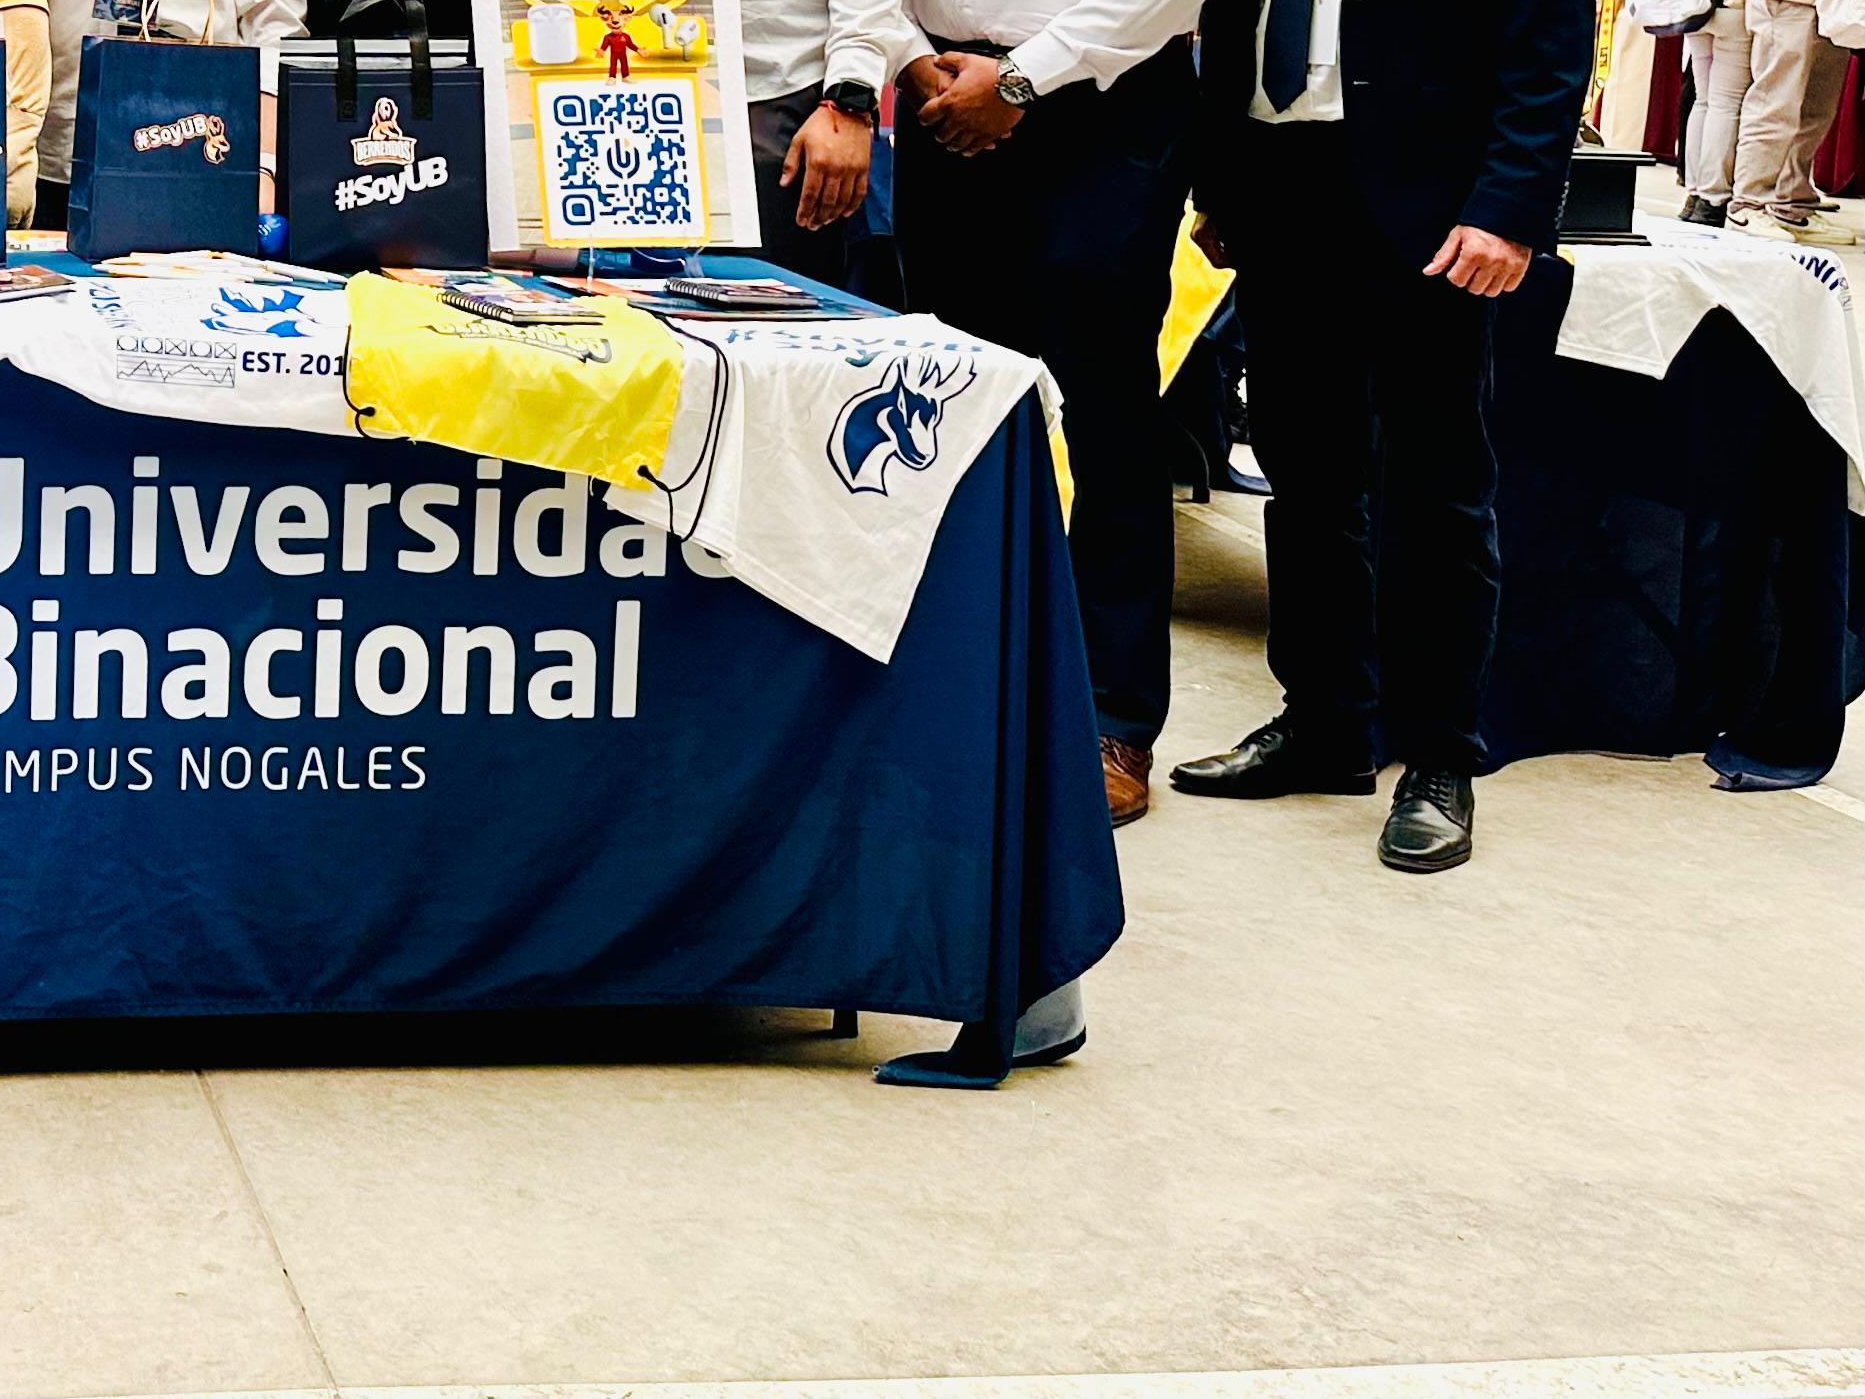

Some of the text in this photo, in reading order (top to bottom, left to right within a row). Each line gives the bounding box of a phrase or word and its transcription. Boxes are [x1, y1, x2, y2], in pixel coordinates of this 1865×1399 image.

[135, 116, 207, 149] #SoyUB
[335, 156, 449, 212] #SoyUB
[242, 351, 351, 376] EST. 201
[179, 745, 427, 791] NOGALES
